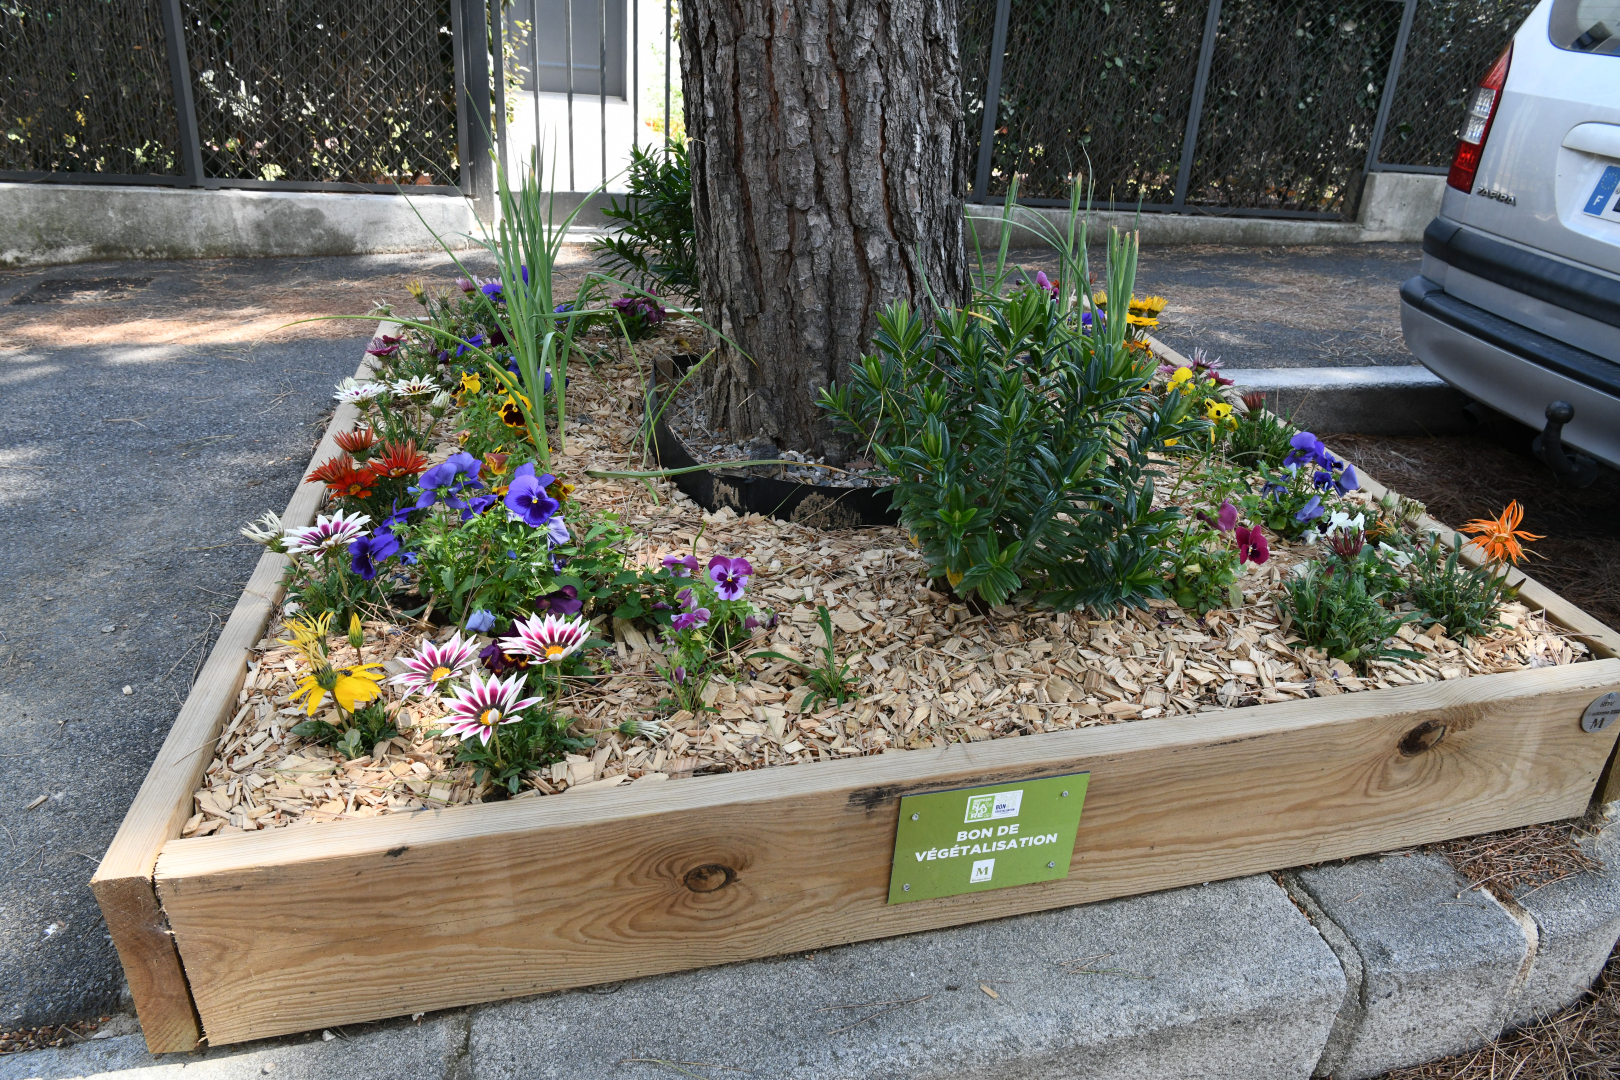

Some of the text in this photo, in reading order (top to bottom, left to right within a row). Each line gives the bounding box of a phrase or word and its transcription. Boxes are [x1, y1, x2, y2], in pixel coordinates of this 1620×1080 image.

[1477, 187, 1516, 206] ZAFIRA
[1593, 195, 1603, 205] F
[1590, 717, 1605, 729] M
[957, 824, 1020, 841] BON DE
[915, 833, 1058, 862] VÉGÉTALISATION
[976, 866, 989, 876] M
